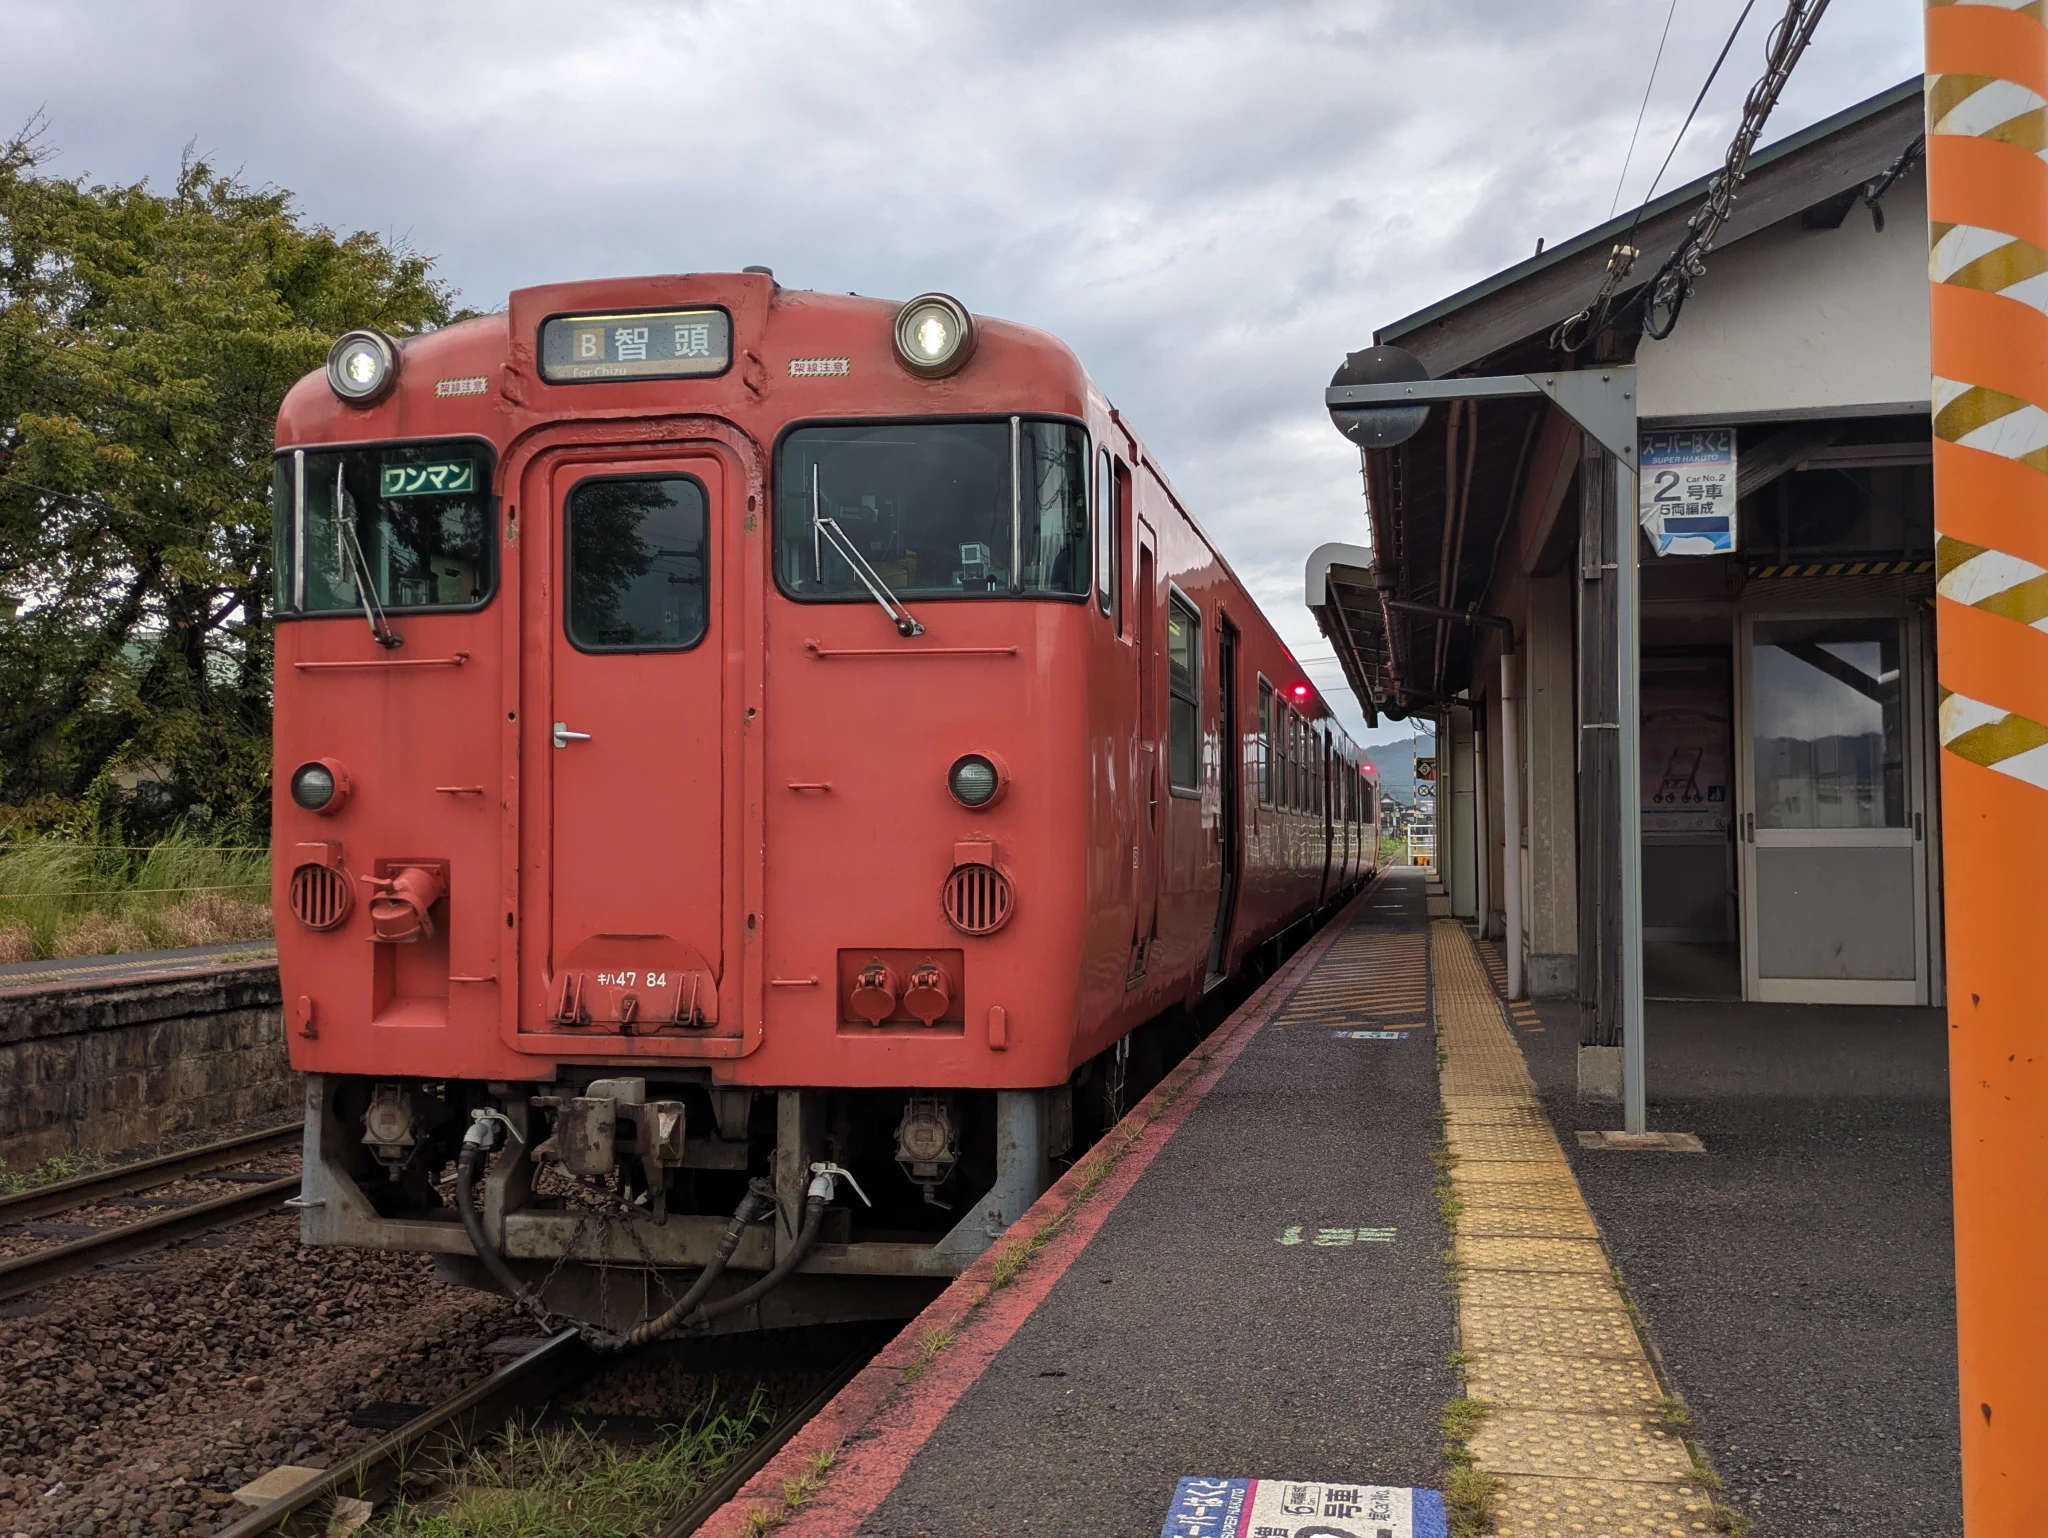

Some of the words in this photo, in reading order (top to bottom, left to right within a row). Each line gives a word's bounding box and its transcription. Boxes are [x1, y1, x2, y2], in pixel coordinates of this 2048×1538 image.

[581, 334, 597, 357] B
[614, 323, 710, 361] 智頭
[573, 367, 592, 377] For
[594, 366, 627, 376] Chizu
[794, 361, 844, 373] 架線注意
[440, 380, 483, 394] 架線注意
[1642, 432, 1729, 456] スーパーはくと
[1652, 456, 1681, 465] SUPER
[1682, 454, 1719, 464] HAKUTO
[385, 464, 470, 493] ワンマン
[1654, 470, 1682, 503] 2
[1686, 484, 1723, 501] 号車
[1686, 476, 1701, 484] Car
[1660, 502, 1715, 517] 5両編成
[597, 971, 637, 987] キハ47
[646, 972, 667, 988] 84
[1172, 1480, 1229, 1538] ーパーはくと
[1226, 1488, 1246, 1516] HAKUTO
[1323, 1488, 1363, 1519] 号車
